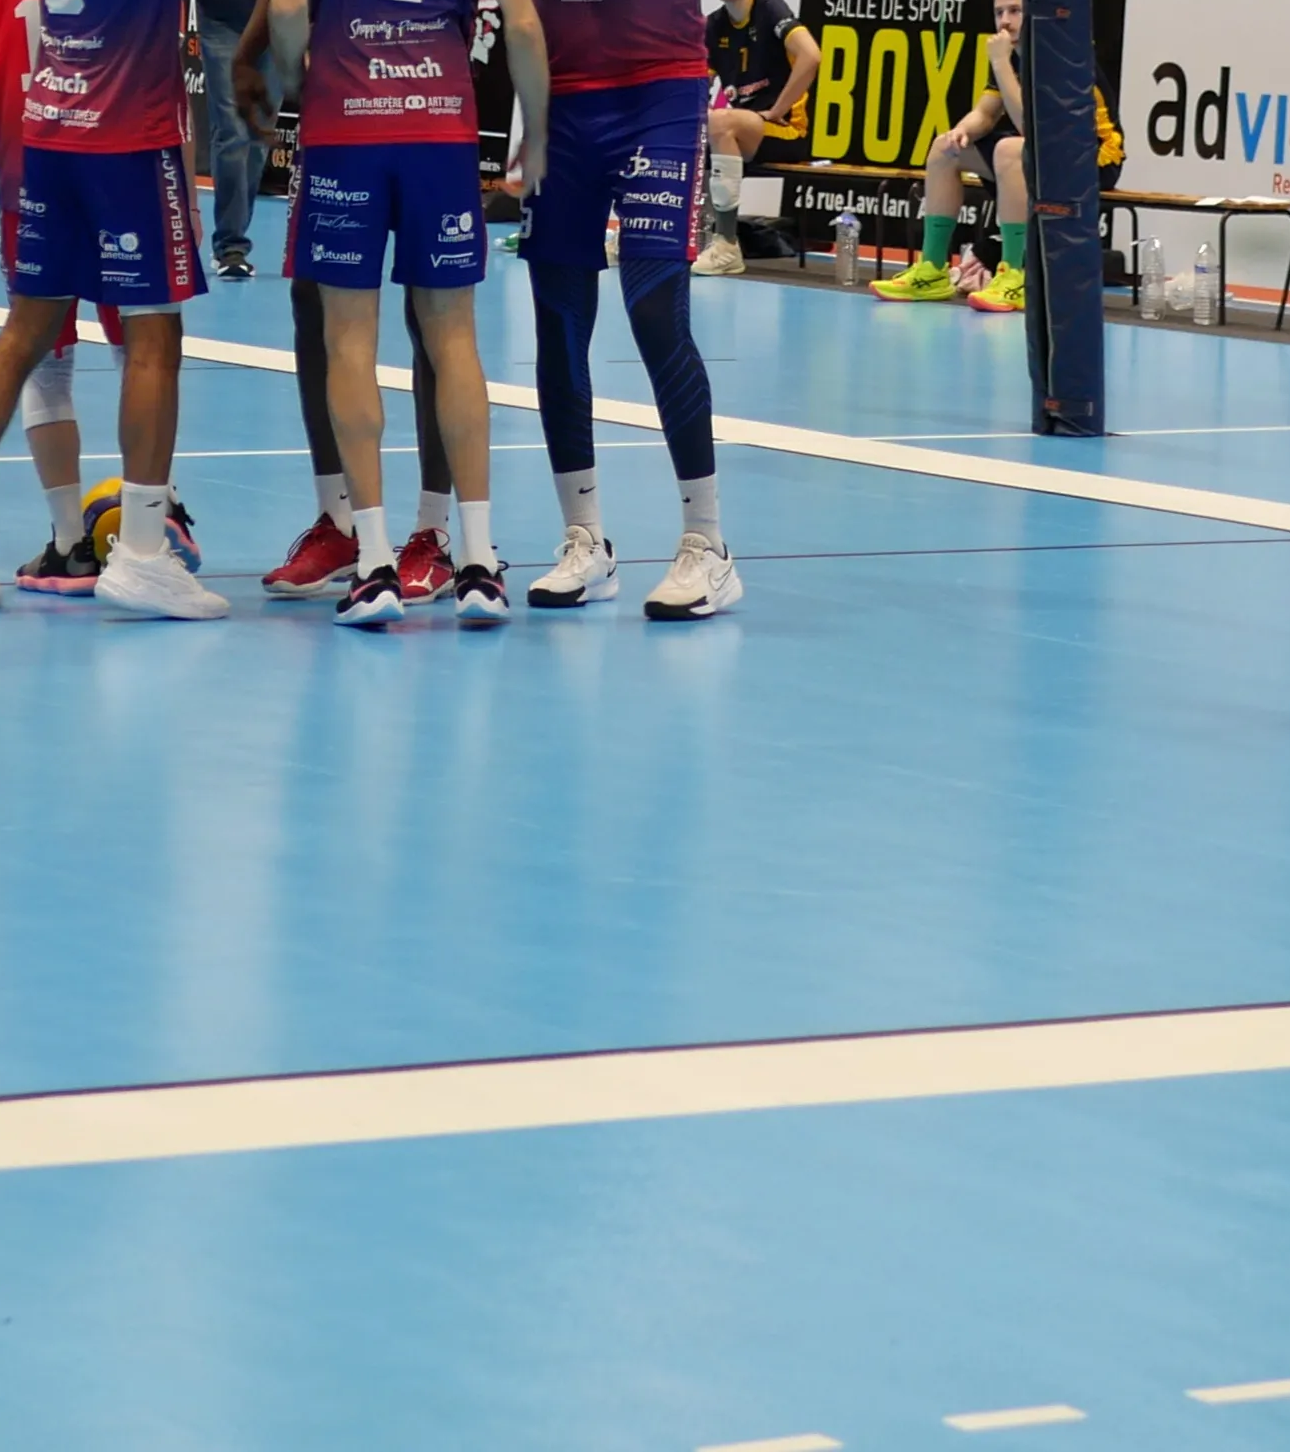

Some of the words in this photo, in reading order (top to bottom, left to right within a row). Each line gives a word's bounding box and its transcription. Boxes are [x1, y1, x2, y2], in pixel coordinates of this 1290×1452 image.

[310, 175, 338, 189] TEAM
[817, 191, 845, 211] rue
[172, 244, 190, 286] B.H.F.
